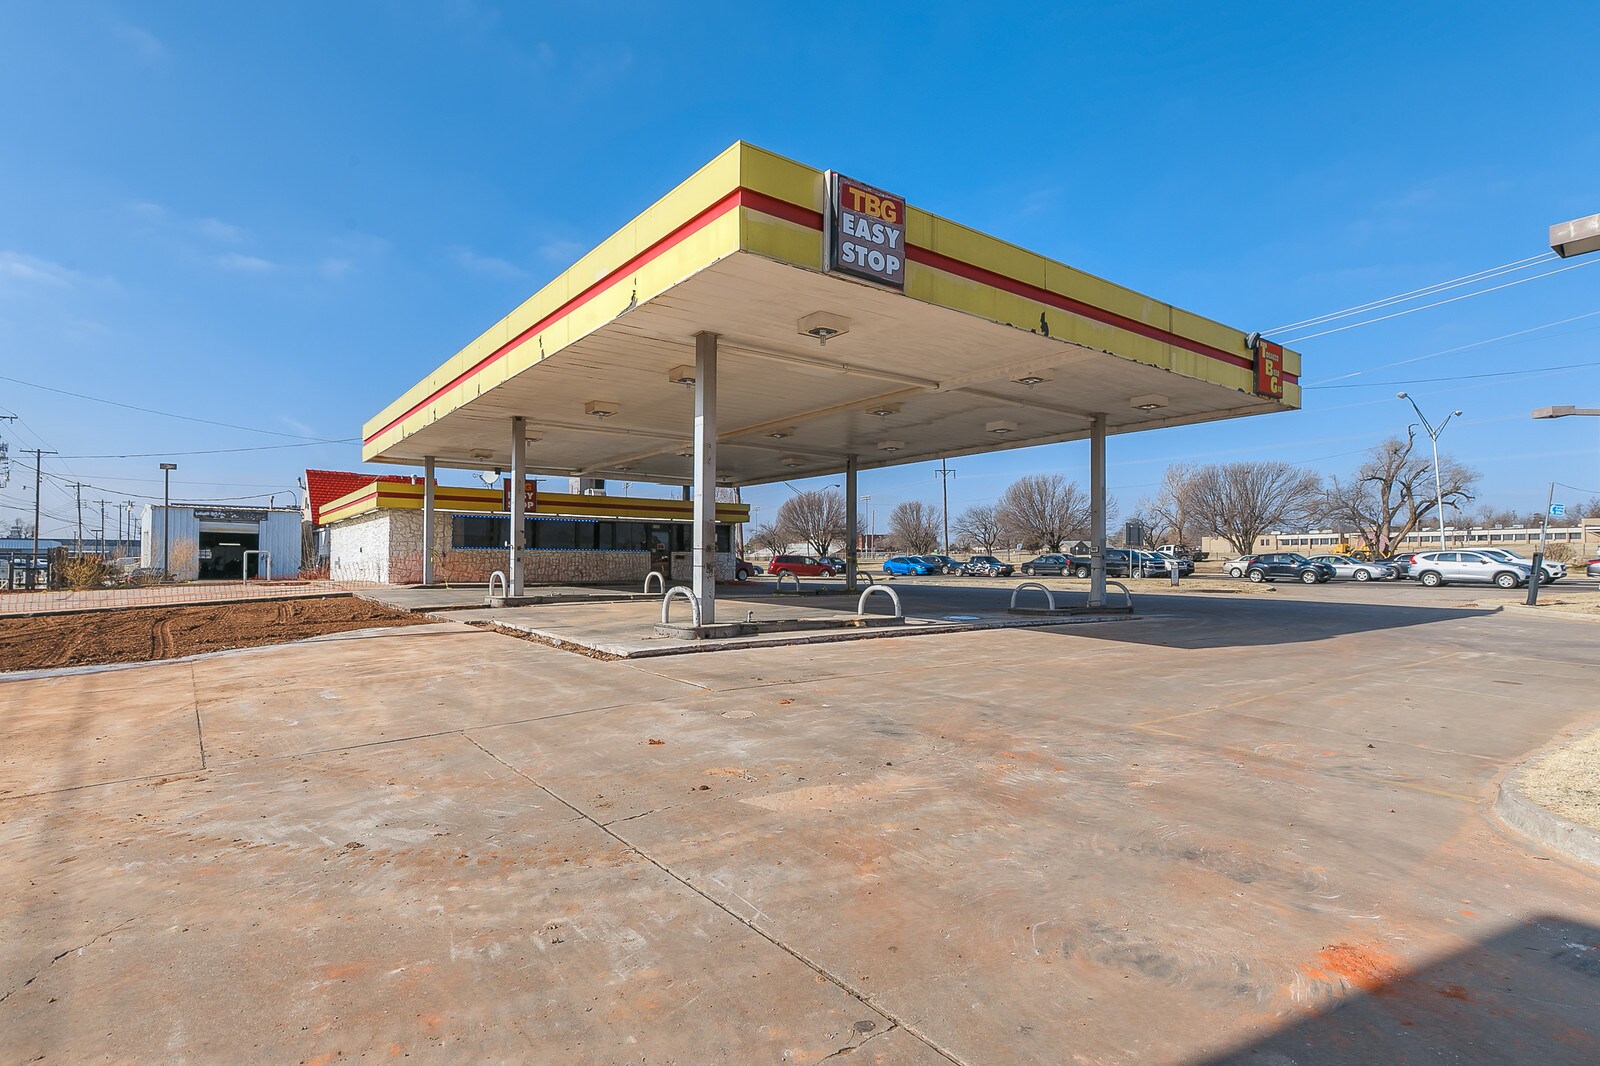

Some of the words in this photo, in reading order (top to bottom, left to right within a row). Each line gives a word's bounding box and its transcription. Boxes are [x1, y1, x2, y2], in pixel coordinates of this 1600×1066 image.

[849, 186, 897, 223] TBG
[842, 212, 900, 249] EASY
[842, 241, 900, 275] STOP
